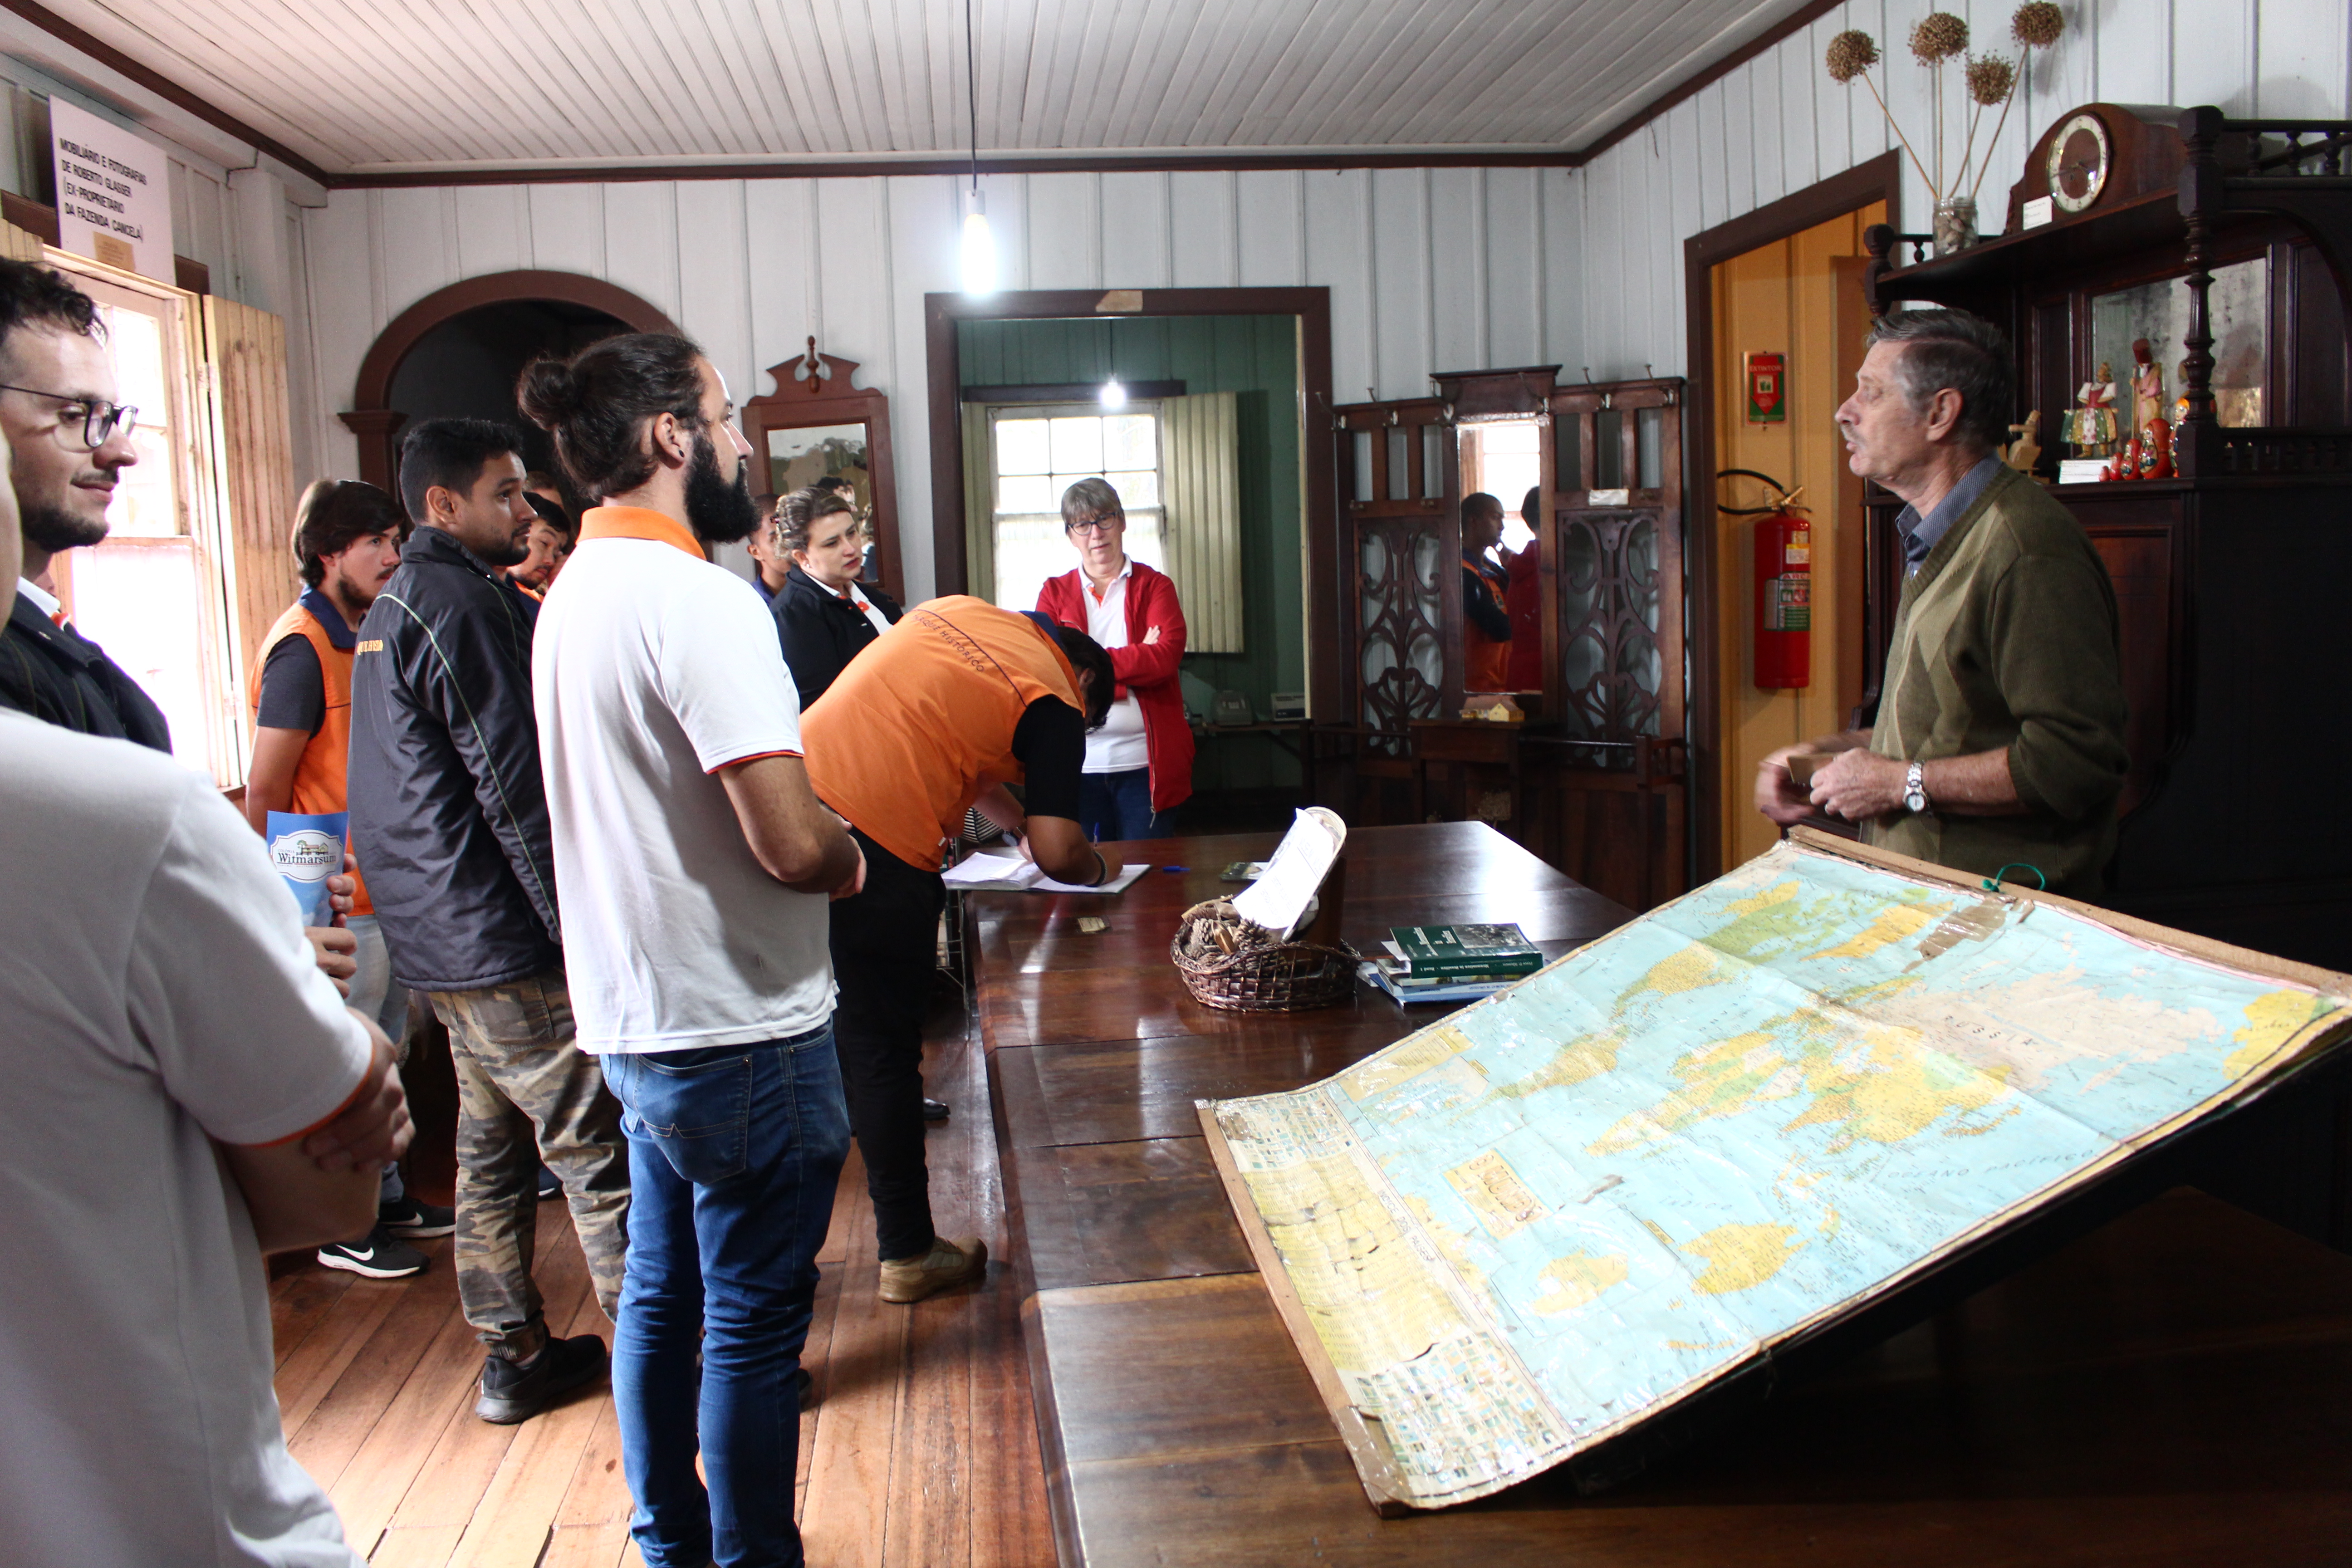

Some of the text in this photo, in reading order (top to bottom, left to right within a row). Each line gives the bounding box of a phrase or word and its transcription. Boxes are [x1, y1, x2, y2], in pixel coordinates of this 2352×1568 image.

[61, 159, 132, 198] DE ROBERTO GLASSER
[101, 155, 108, 168] E
[108, 158, 147, 185] FOTOGRAFIAS
[64, 201, 144, 243] DA FAZENDA CANCELA)
[278, 852, 336, 863] Witmarsum
